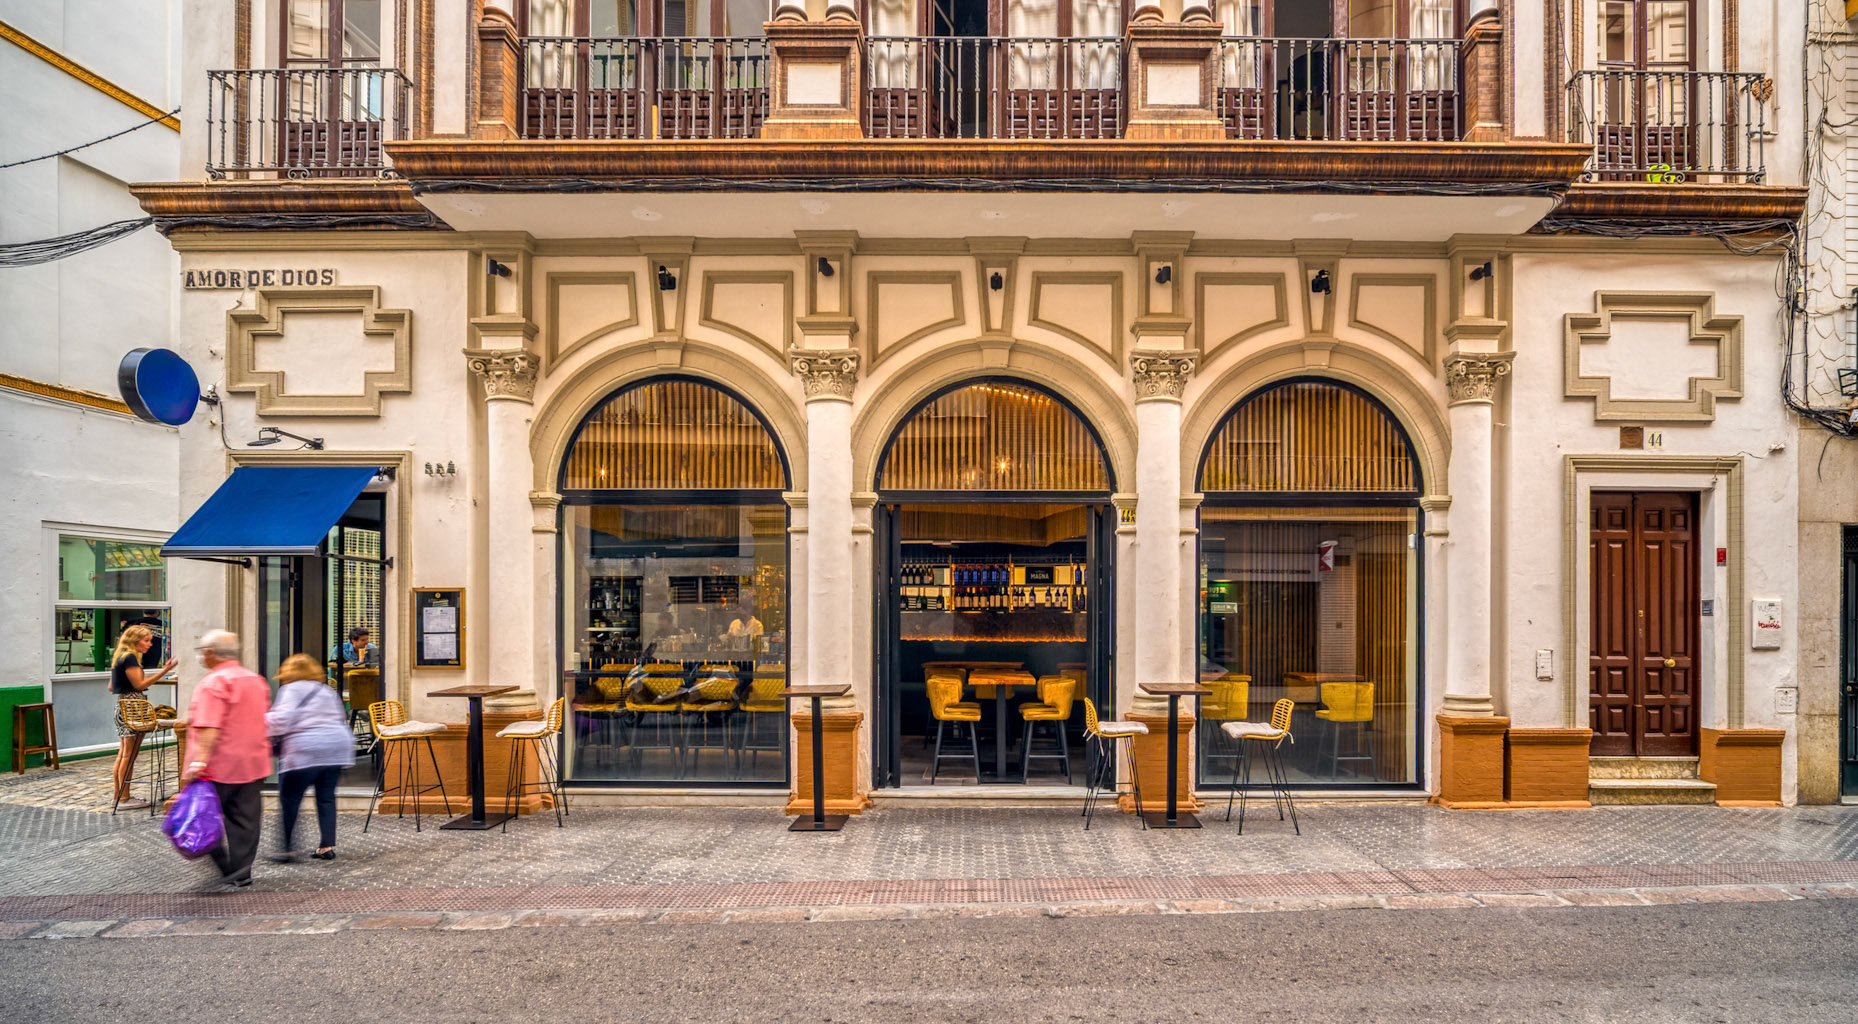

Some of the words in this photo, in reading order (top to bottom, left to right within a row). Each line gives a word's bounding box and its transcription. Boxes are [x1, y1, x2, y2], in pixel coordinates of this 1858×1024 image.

[185, 271, 241, 287] AMOR
[247, 270, 275, 286] DE
[282, 269, 333, 286] DIOS
[1648, 433, 1662, 447] 44
